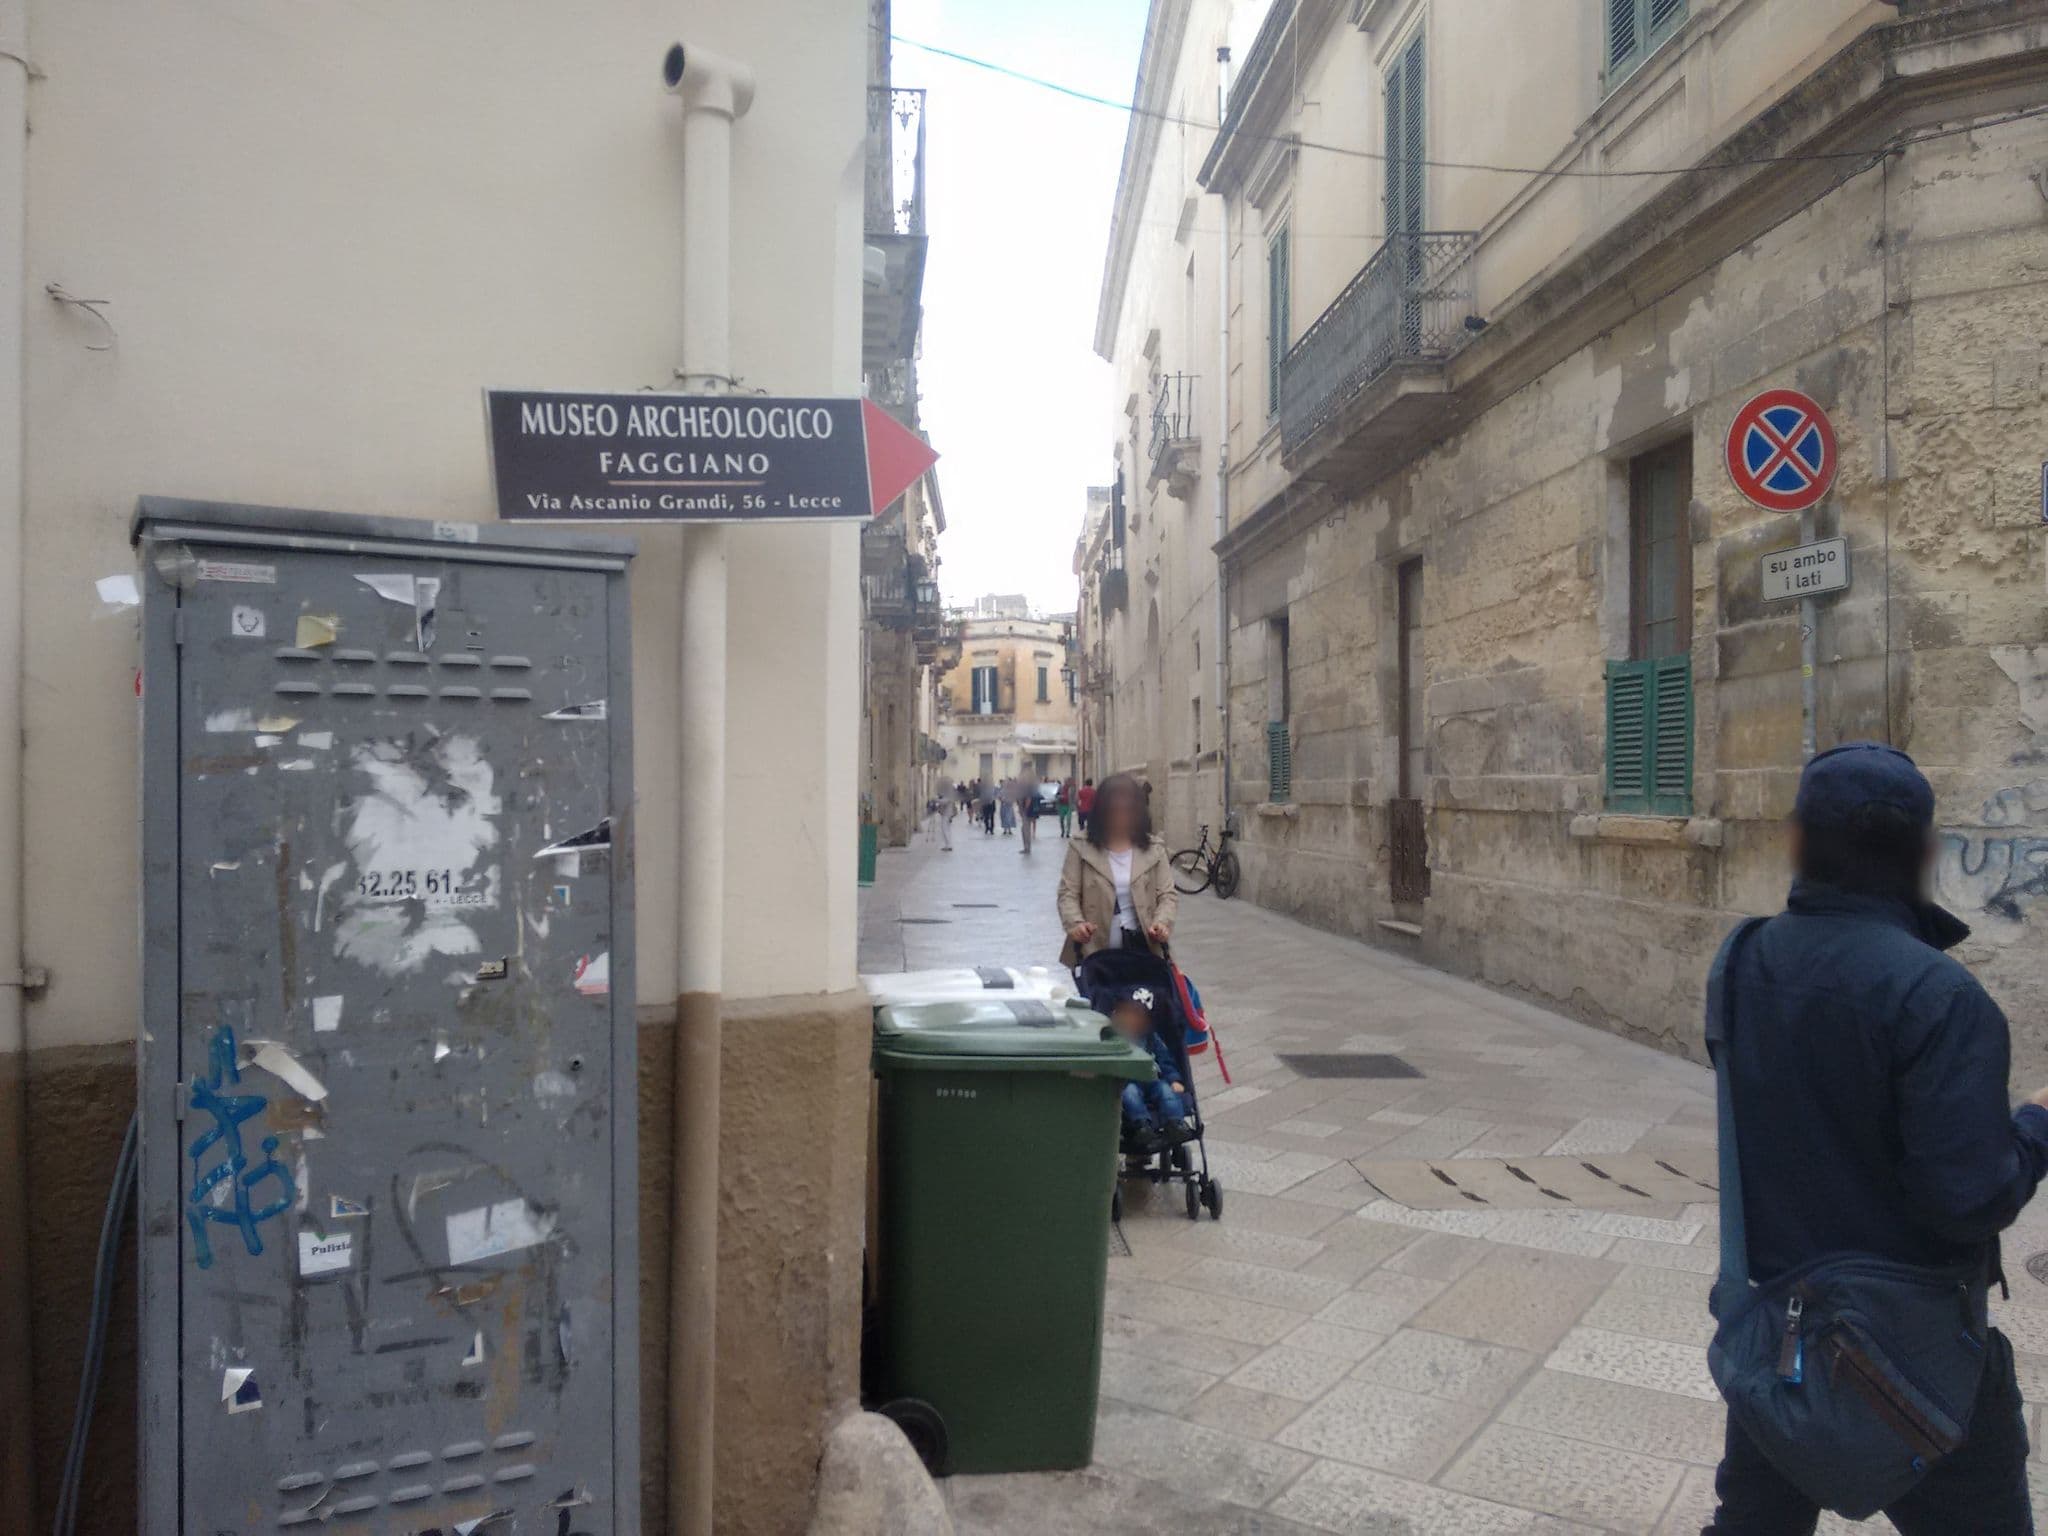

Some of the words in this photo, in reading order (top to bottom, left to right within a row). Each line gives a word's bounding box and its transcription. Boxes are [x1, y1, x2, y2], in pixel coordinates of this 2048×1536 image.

[521, 401, 619, 437] MUSEO
[627, 405, 833, 439] ARCHEOLOGICO
[600, 451, 770, 475] FAGGIANO
[527, 493, 561, 511] Via
[570, 494, 651, 511] Ascanio
[659, 493, 735, 512] Grandi,
[743, 494, 766, 510] 56
[788, 493, 842, 510] Lecce
[1770, 560, 1788, 574] su
[1793, 549, 1837, 569] ambo
[1784, 576, 1790, 591] i
[1795, 571, 1823, 589] lati
